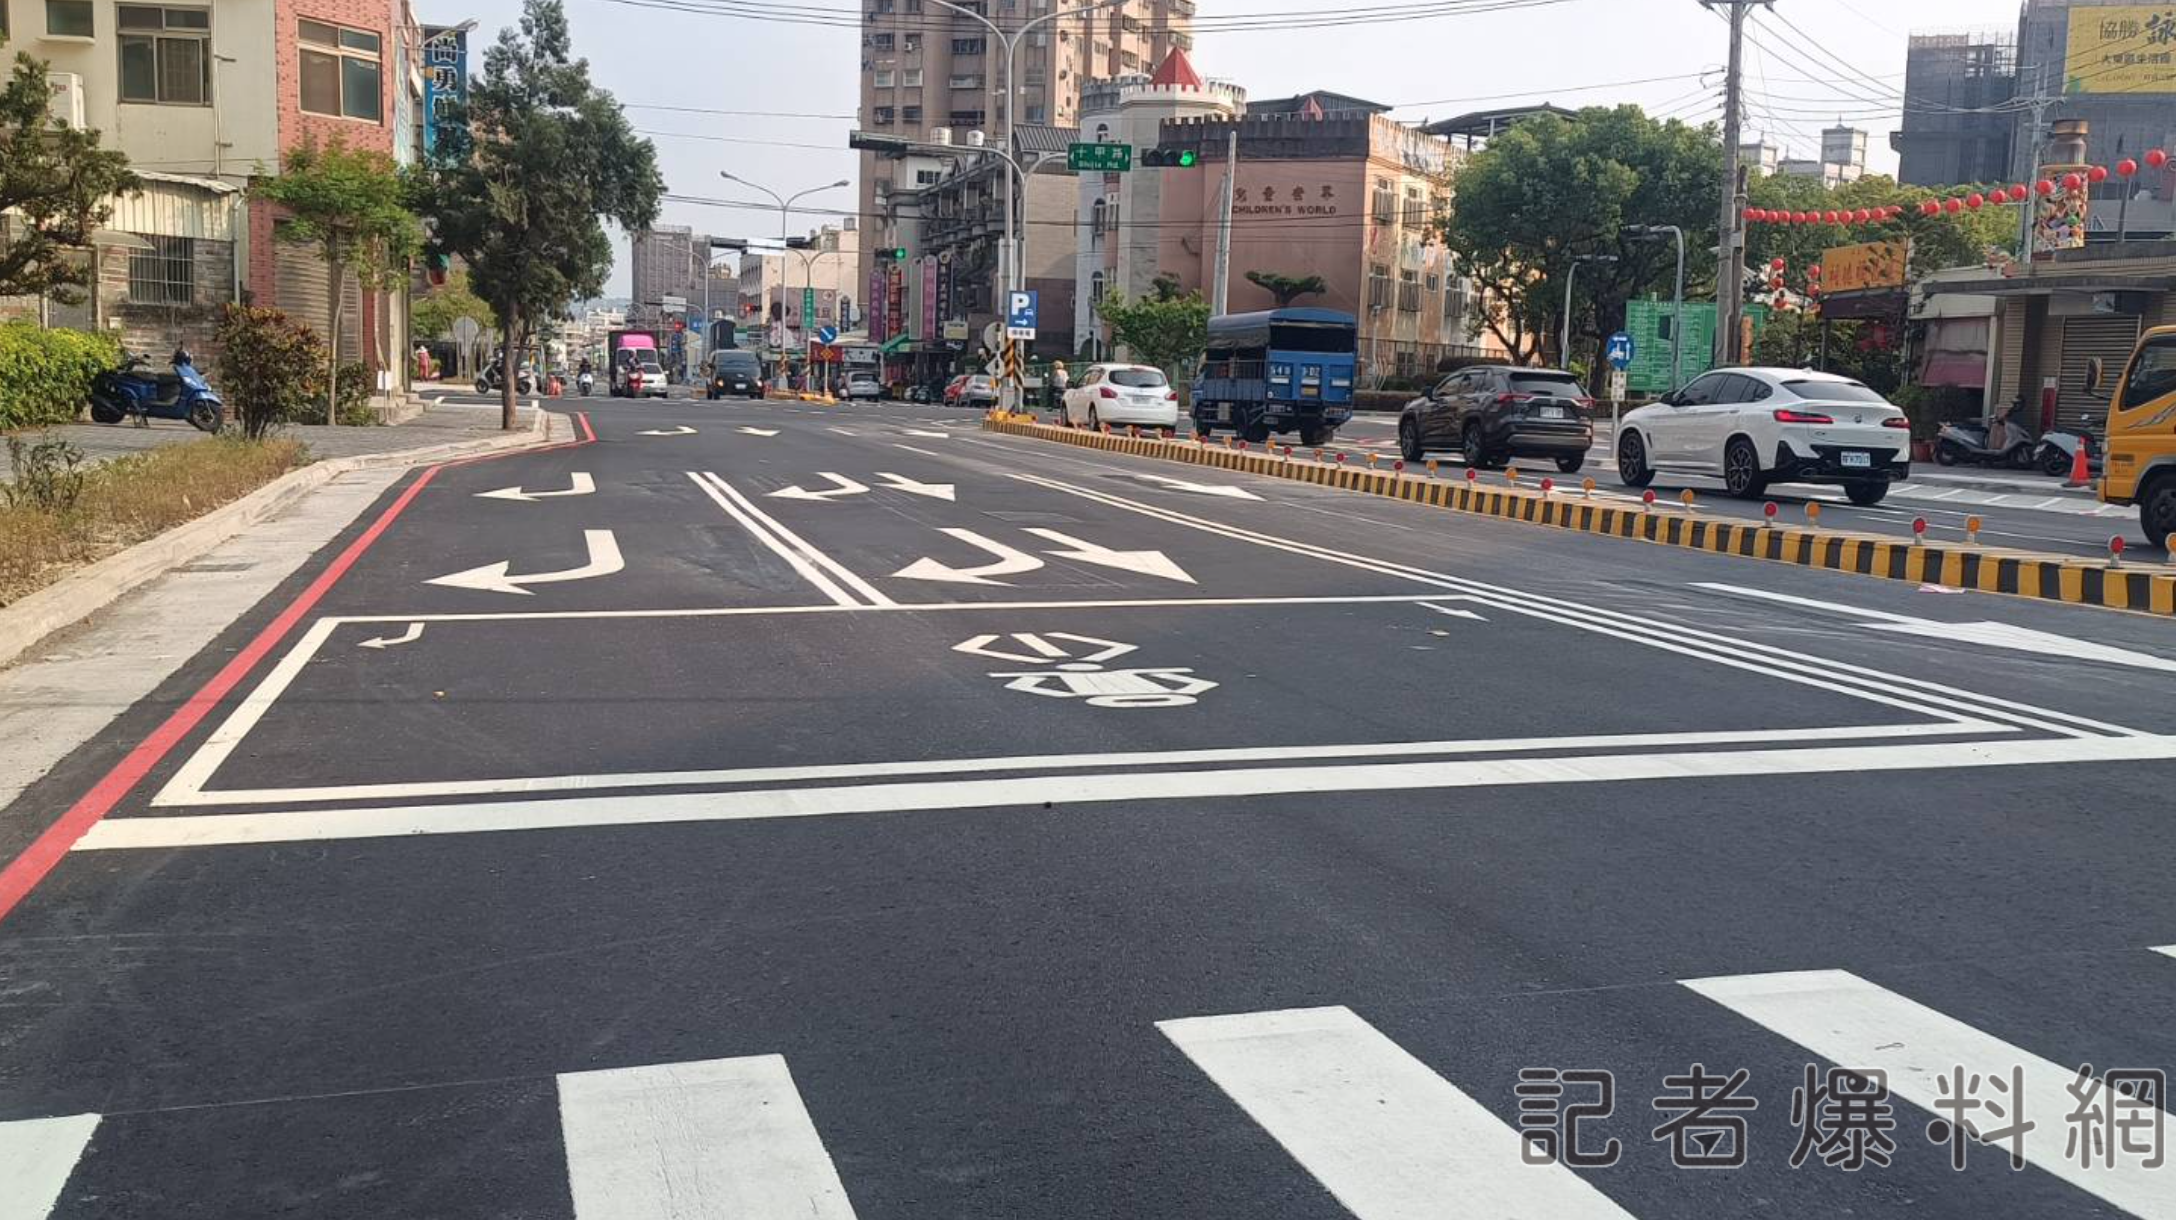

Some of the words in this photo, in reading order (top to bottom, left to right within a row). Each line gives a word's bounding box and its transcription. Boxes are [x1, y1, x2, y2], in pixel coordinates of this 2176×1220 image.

[1074, 145, 1123, 159] 十甲路
[1297, 205, 1337, 215] WORLD
[1011, 293, 1030, 316] P
